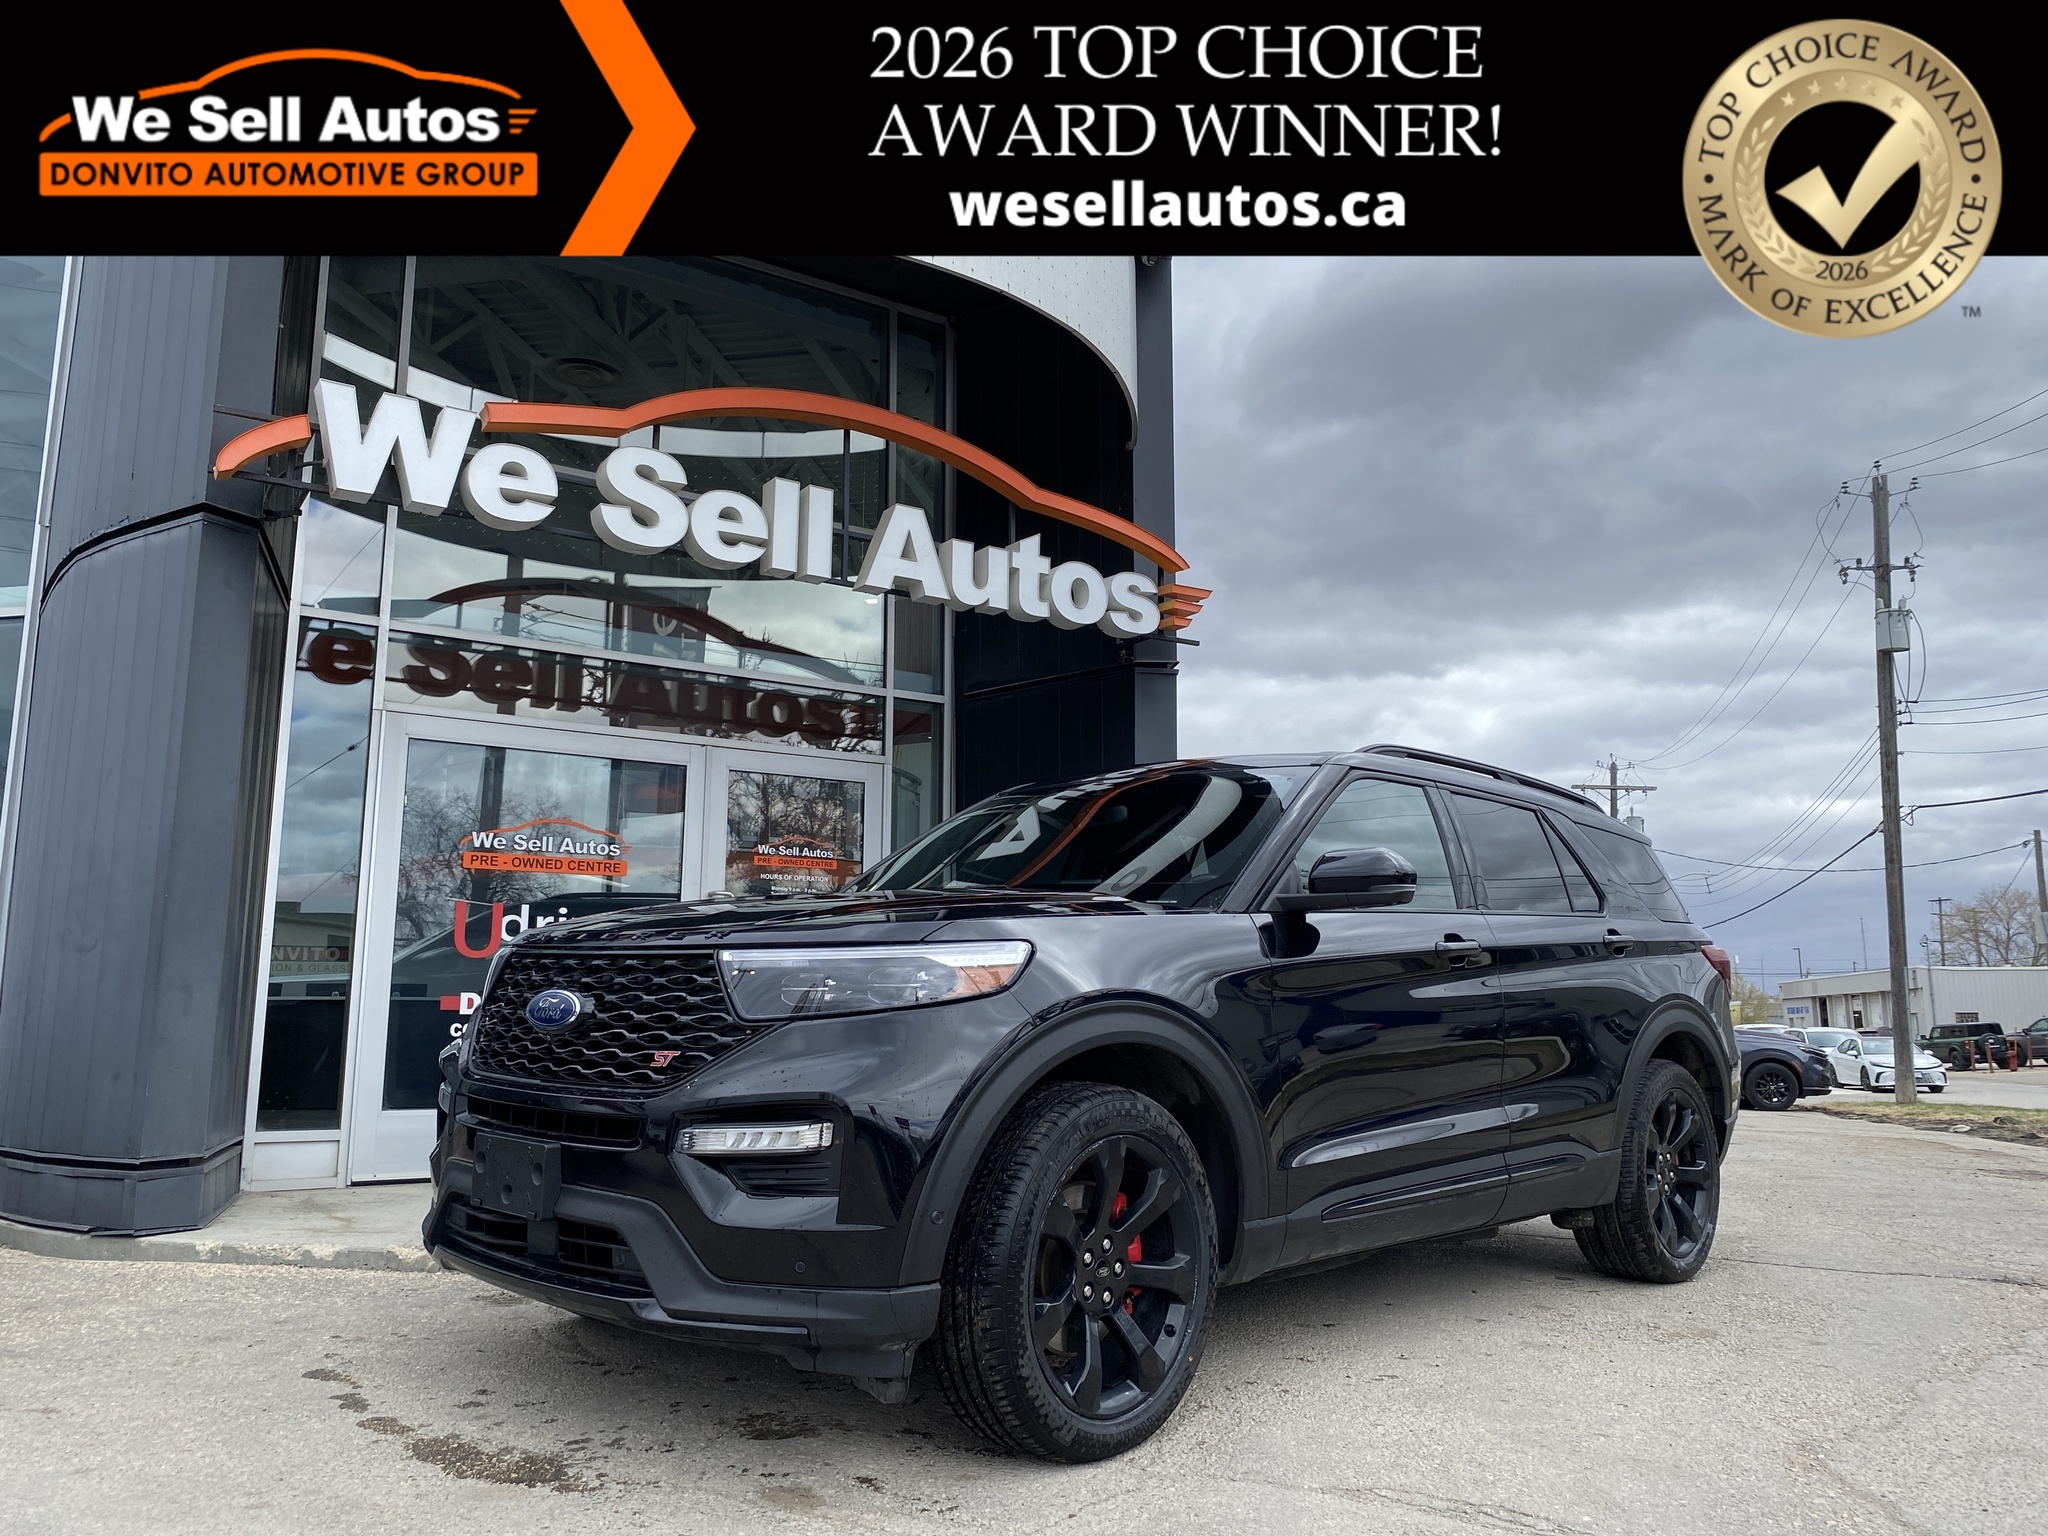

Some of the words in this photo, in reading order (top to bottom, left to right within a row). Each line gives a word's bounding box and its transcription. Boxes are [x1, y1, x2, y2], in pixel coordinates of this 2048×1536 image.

[314, 378, 559, 532] We
[590, 445, 834, 585] Sell
[852, 502, 1161, 639] Autos
[472, 831, 507, 849] We
[514, 834, 553, 852] Sell
[559, 837, 621, 856] Autos
[758, 844, 776, 855] We
[779, 846, 799, 856] Sell
[802, 847, 834, 858] Autos
[470, 855, 498, 867] PRE
[511, 858, 563, 870] OWNED
[567, 860, 621, 873] CENTRE
[777, 858, 805, 867] OWNED
[805, 860, 834, 868] CENTRE
[760, 873, 783, 881] HOURS
[308, 964, 346, 972] GLASS
[534, 997, 566, 1019] Ford
[650, 1050, 682, 1067] ST
